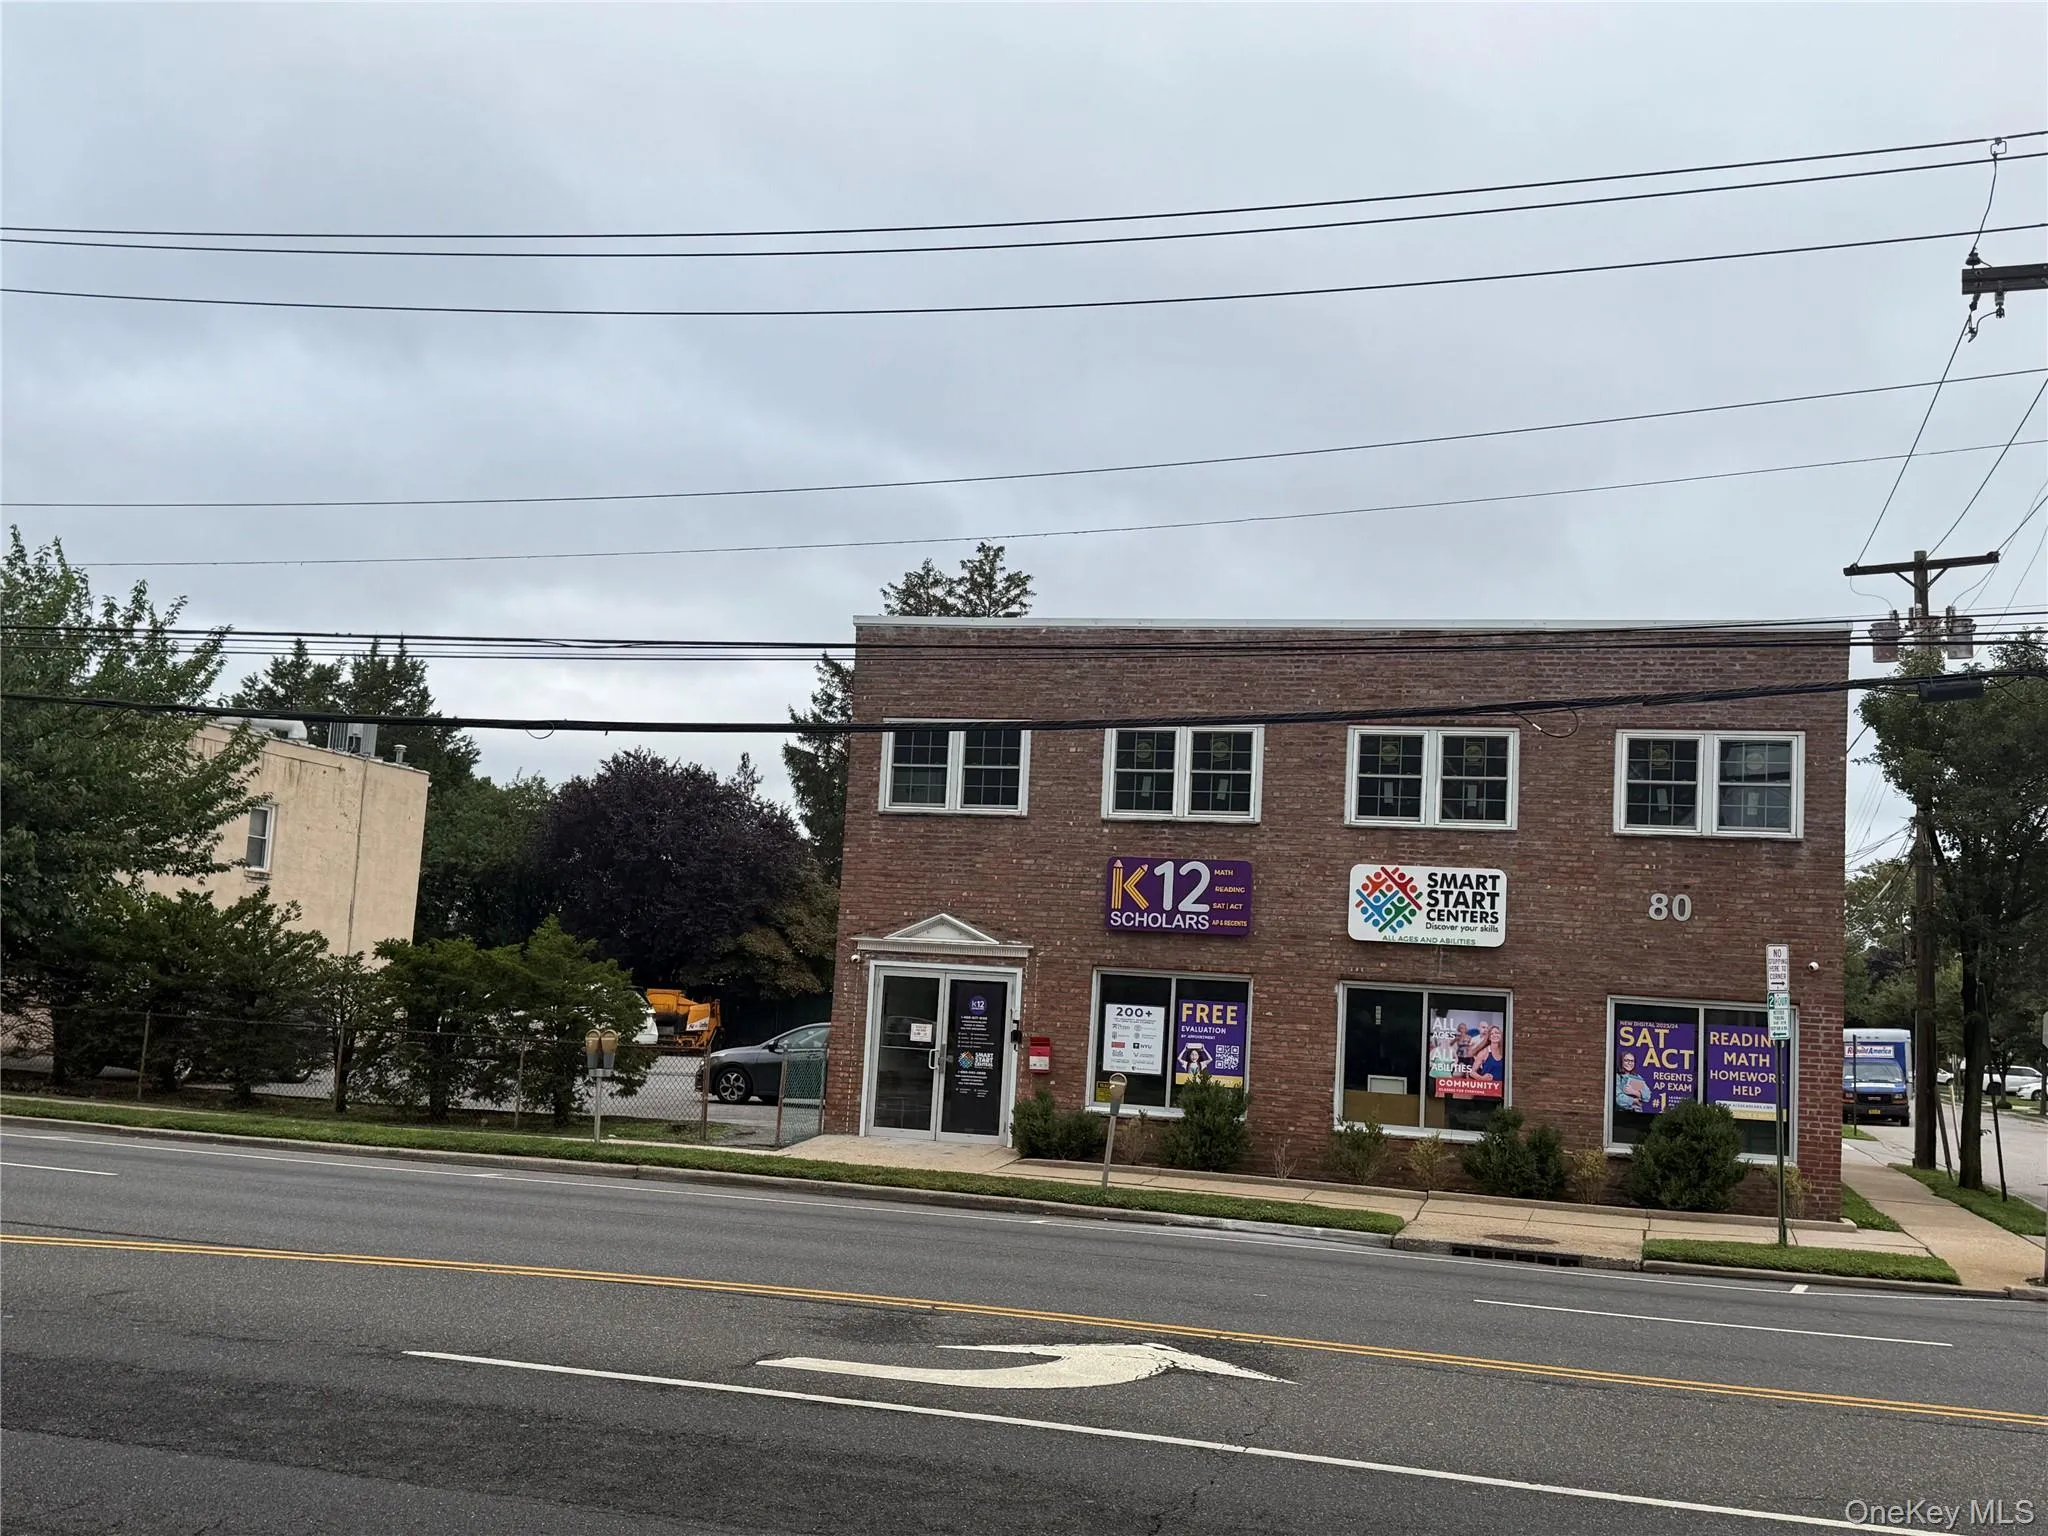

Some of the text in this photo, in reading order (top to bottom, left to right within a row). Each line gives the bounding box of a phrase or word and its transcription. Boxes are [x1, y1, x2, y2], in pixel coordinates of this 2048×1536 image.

[1427, 872, 1500, 891] SMART
[1215, 885, 1246, 893] READING
[1426, 890, 1500, 910] START
[1648, 893, 1692, 922] 80
[1110, 911, 1210, 930] SCHOLARS
[1426, 908, 1499, 925] CENTERS
[1425, 922, 1499, 933] Discover your skills
[1397, 935, 1419, 943] AGES
[1420, 936, 1438, 944] AND
[1440, 937, 1476, 946] ABILITIES
[1773, 948, 1781, 958] NO
[1769, 995, 1774, 1007] 2
[1116, 1006, 1153, 1018] 200+
[1181, 1002, 1238, 1025] FREE
[1180, 1025, 1227, 1035] EVALUATION
[1432, 1017, 1456, 1031] ALL
[1431, 1031, 1456, 1040] AGES
[1619, 1027, 1669, 1049] SAT
[1431, 1049, 1456, 1062] ALL
[1642, 1047, 1694, 1070] ACT
[1723, 1051, 1770, 1068] MATH
[1431, 1063, 1473, 1074] ABILITIES
[1653, 1071, 1693, 1083] REGENTS
[1709, 1069, 1784, 1086] HOMEWOR
[1438, 1079, 1500, 1091] COMMUNITY
[1653, 1082, 1692, 1092] AP EXAM
[1732, 1084, 1762, 1097] HELP
